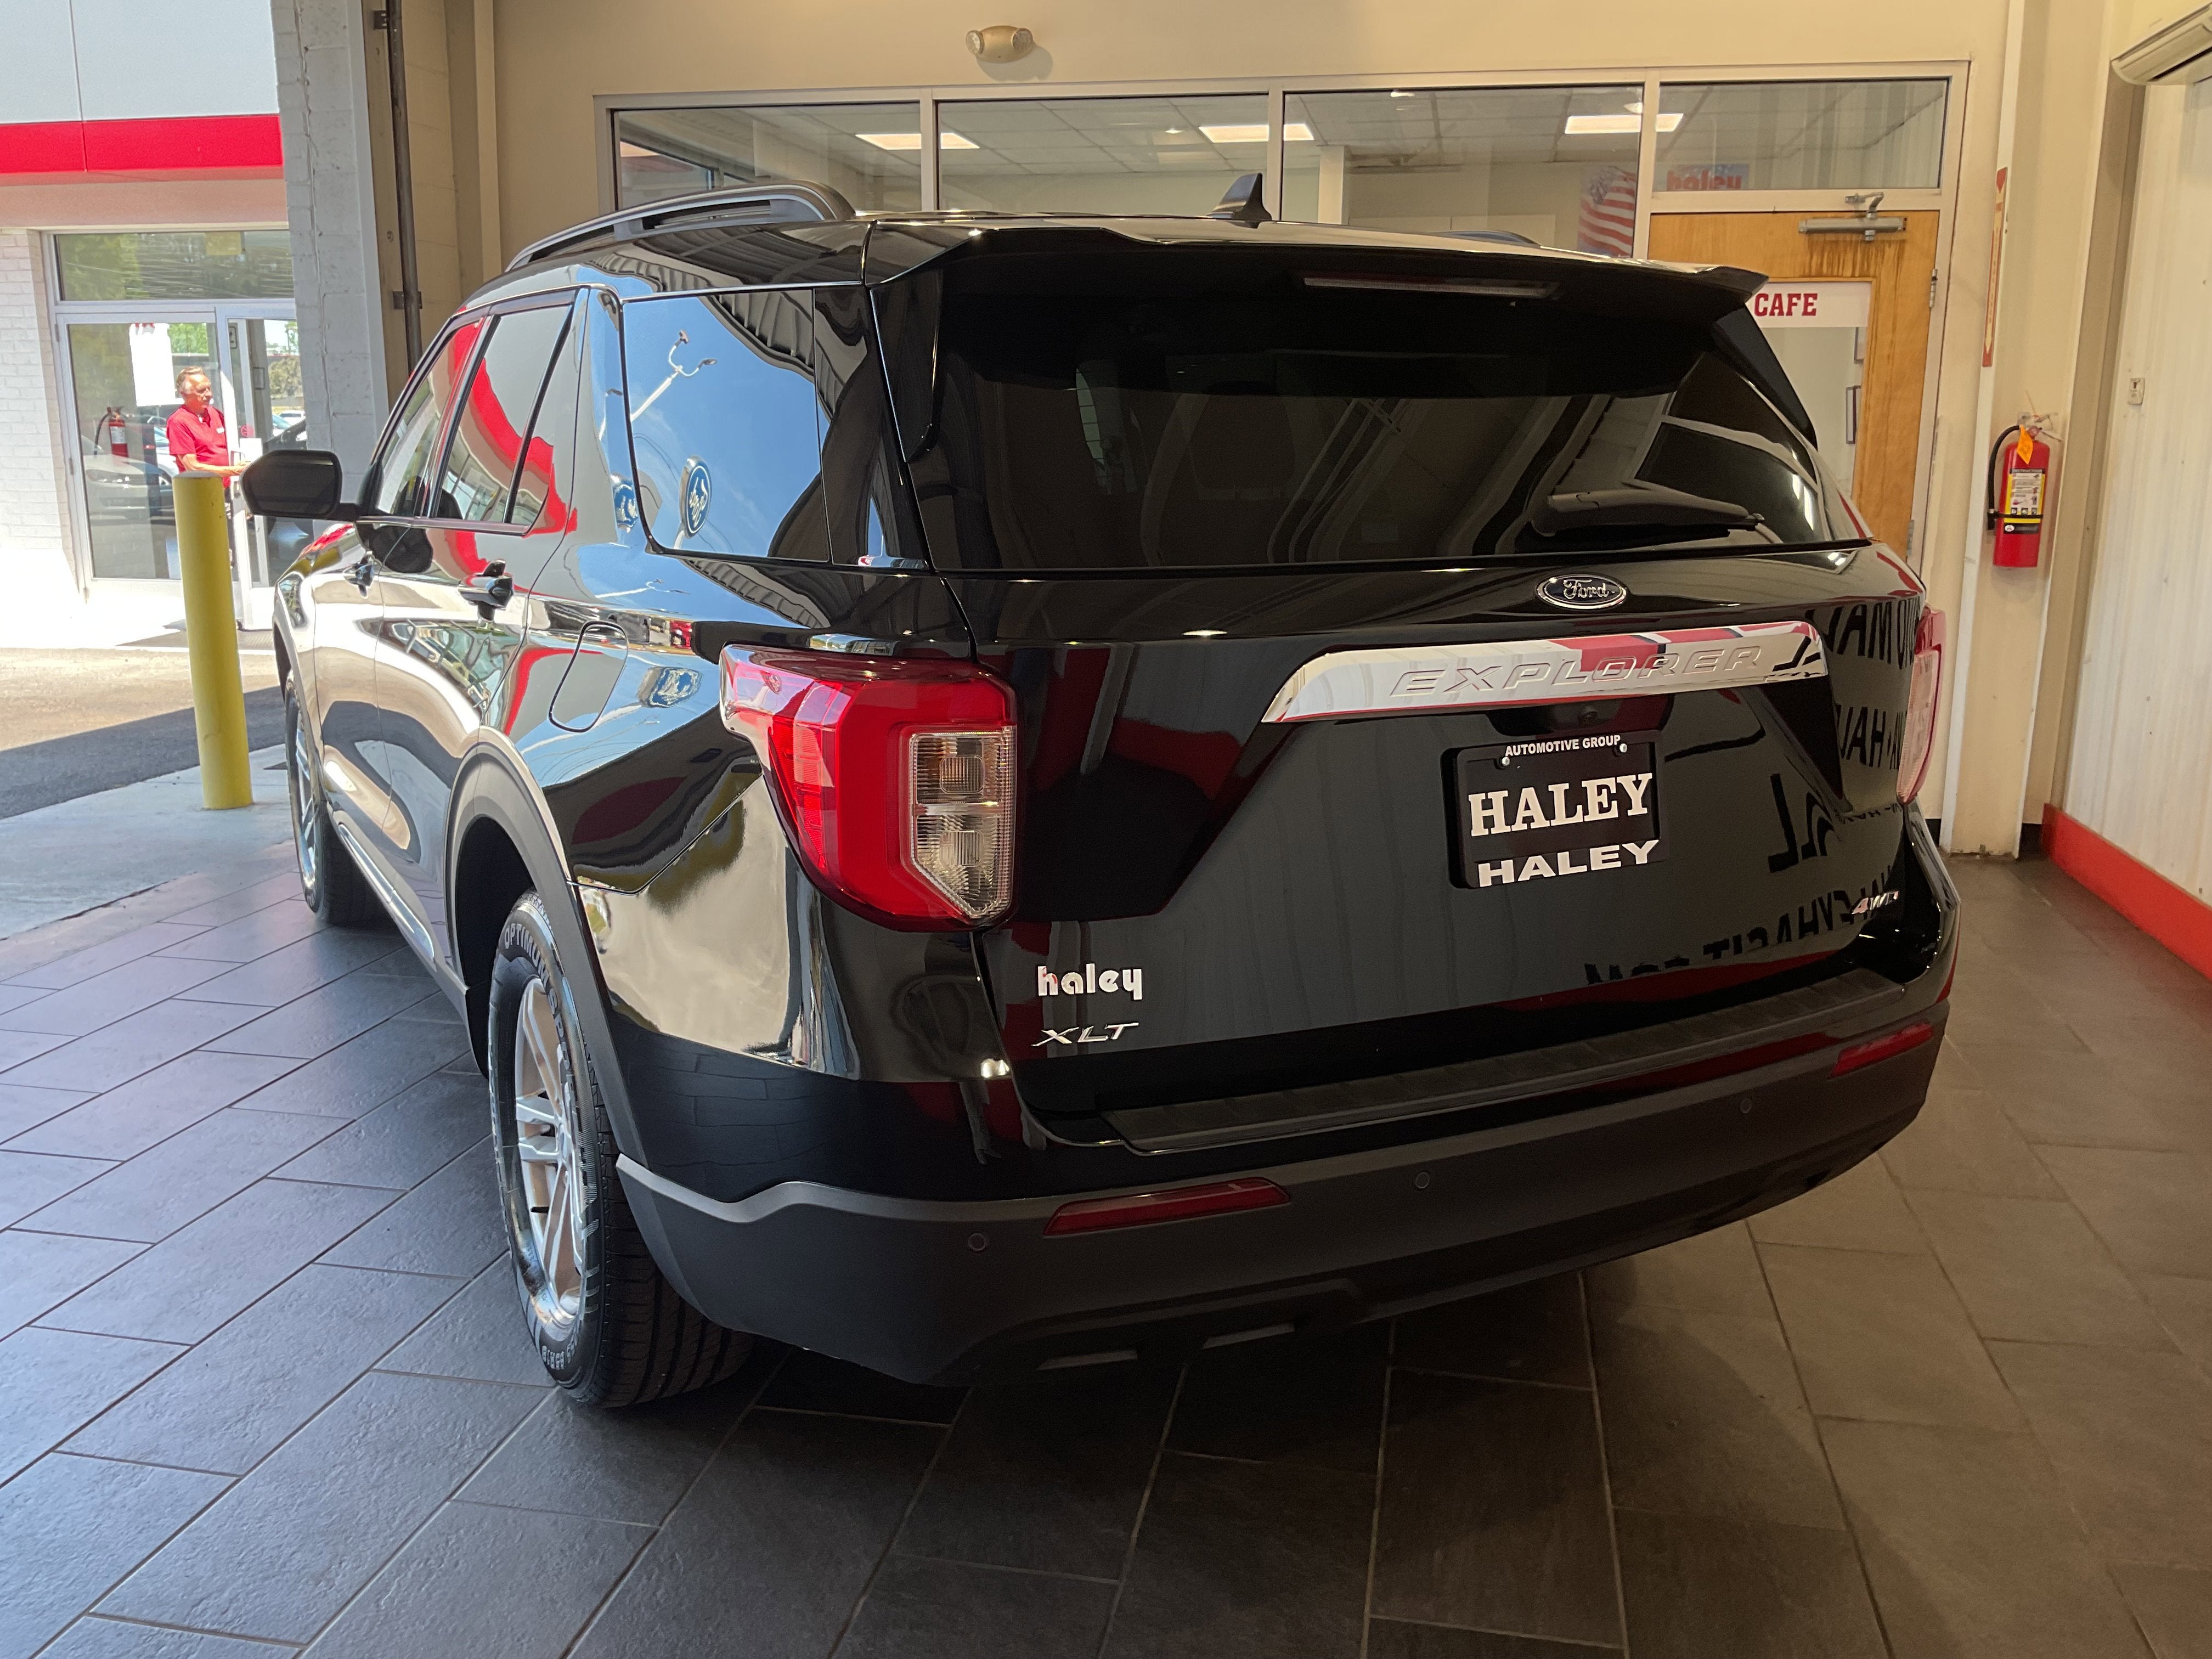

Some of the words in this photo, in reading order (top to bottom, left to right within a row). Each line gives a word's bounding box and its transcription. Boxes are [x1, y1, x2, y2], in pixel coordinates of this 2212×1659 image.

[1754, 293, 1818, 317] CAFE
[1563, 579, 1609, 599] Ford
[1390, 645, 1762, 697] EXPLORER
[1505, 738, 1580, 757] AUTOMOTIVE
[1582, 735, 1621, 749] GROUP
[1468, 772, 1652, 837] HALEY
[1478, 839, 1659, 887] HALEY
[1037, 963, 1143, 1000] haley
[1031, 1022, 1139, 1047] XLT
